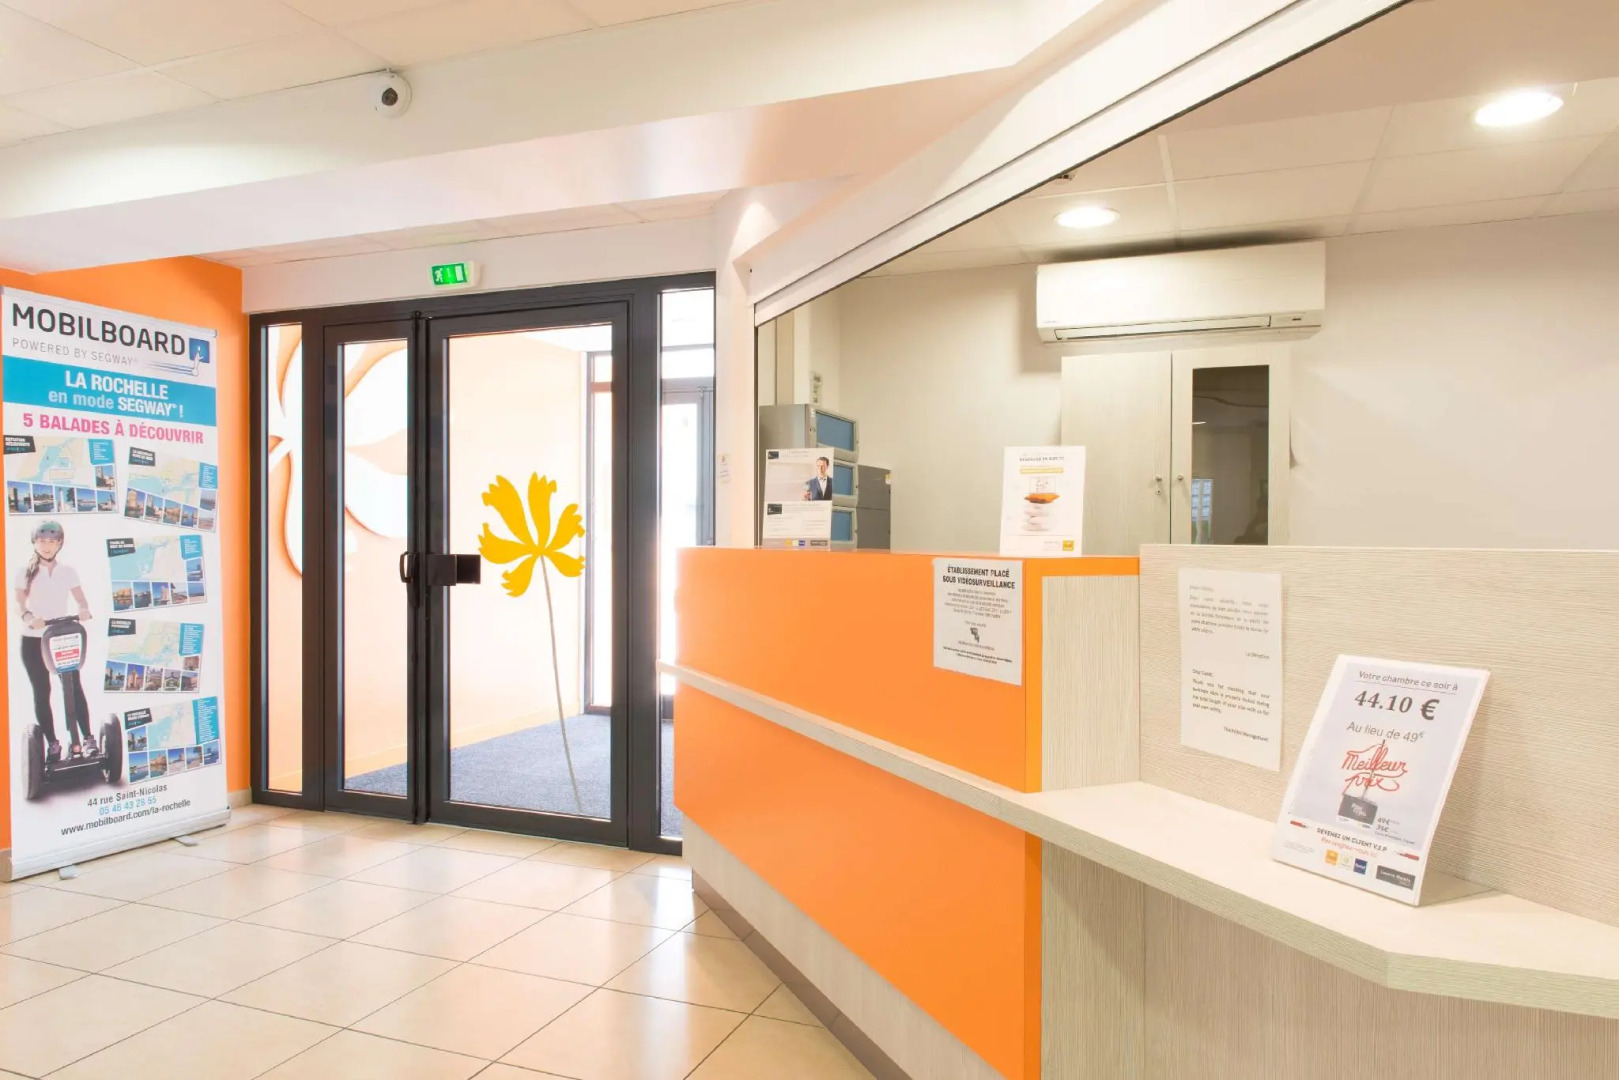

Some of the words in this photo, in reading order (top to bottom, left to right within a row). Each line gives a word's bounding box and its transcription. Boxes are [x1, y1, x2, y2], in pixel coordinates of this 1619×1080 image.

[12, 303, 186, 356] MOBILBOARD
[12, 337, 70, 356] POWERED
[74, 348, 88, 359] BY
[65, 370, 87, 389] LA
[91, 374, 168, 400] ROCHELLE
[48, 390, 67, 404] en
[73, 391, 114, 410] mode
[23, 412, 34, 428] 5
[40, 414, 110, 435] BALADES
[115, 419, 125, 436] À
[129, 422, 204, 444] DÉCOUVRIR
[942, 575, 957, 584] SOUS
[1358, 671, 1382, 681] Votre
[1382, 675, 1420, 686] chambre
[1420, 680, 1432, 688] ce
[1452, 683, 1459, 691] à
[1355, 690, 1413, 713] 44.10
[1420, 698, 1440, 720] €
[1346, 721, 1363, 733] Au
[1364, 724, 1384, 737] lieu
[1386, 728, 1401, 740] de
[1341, 746, 1408, 773] Meilleur
[87, 798, 98, 807] 44
[100, 796, 114, 805] rue
[116, 784, 168, 802] Saint-Nicolas
[99, 806, 110, 816] 05
[124, 801, 134, 810] 43
